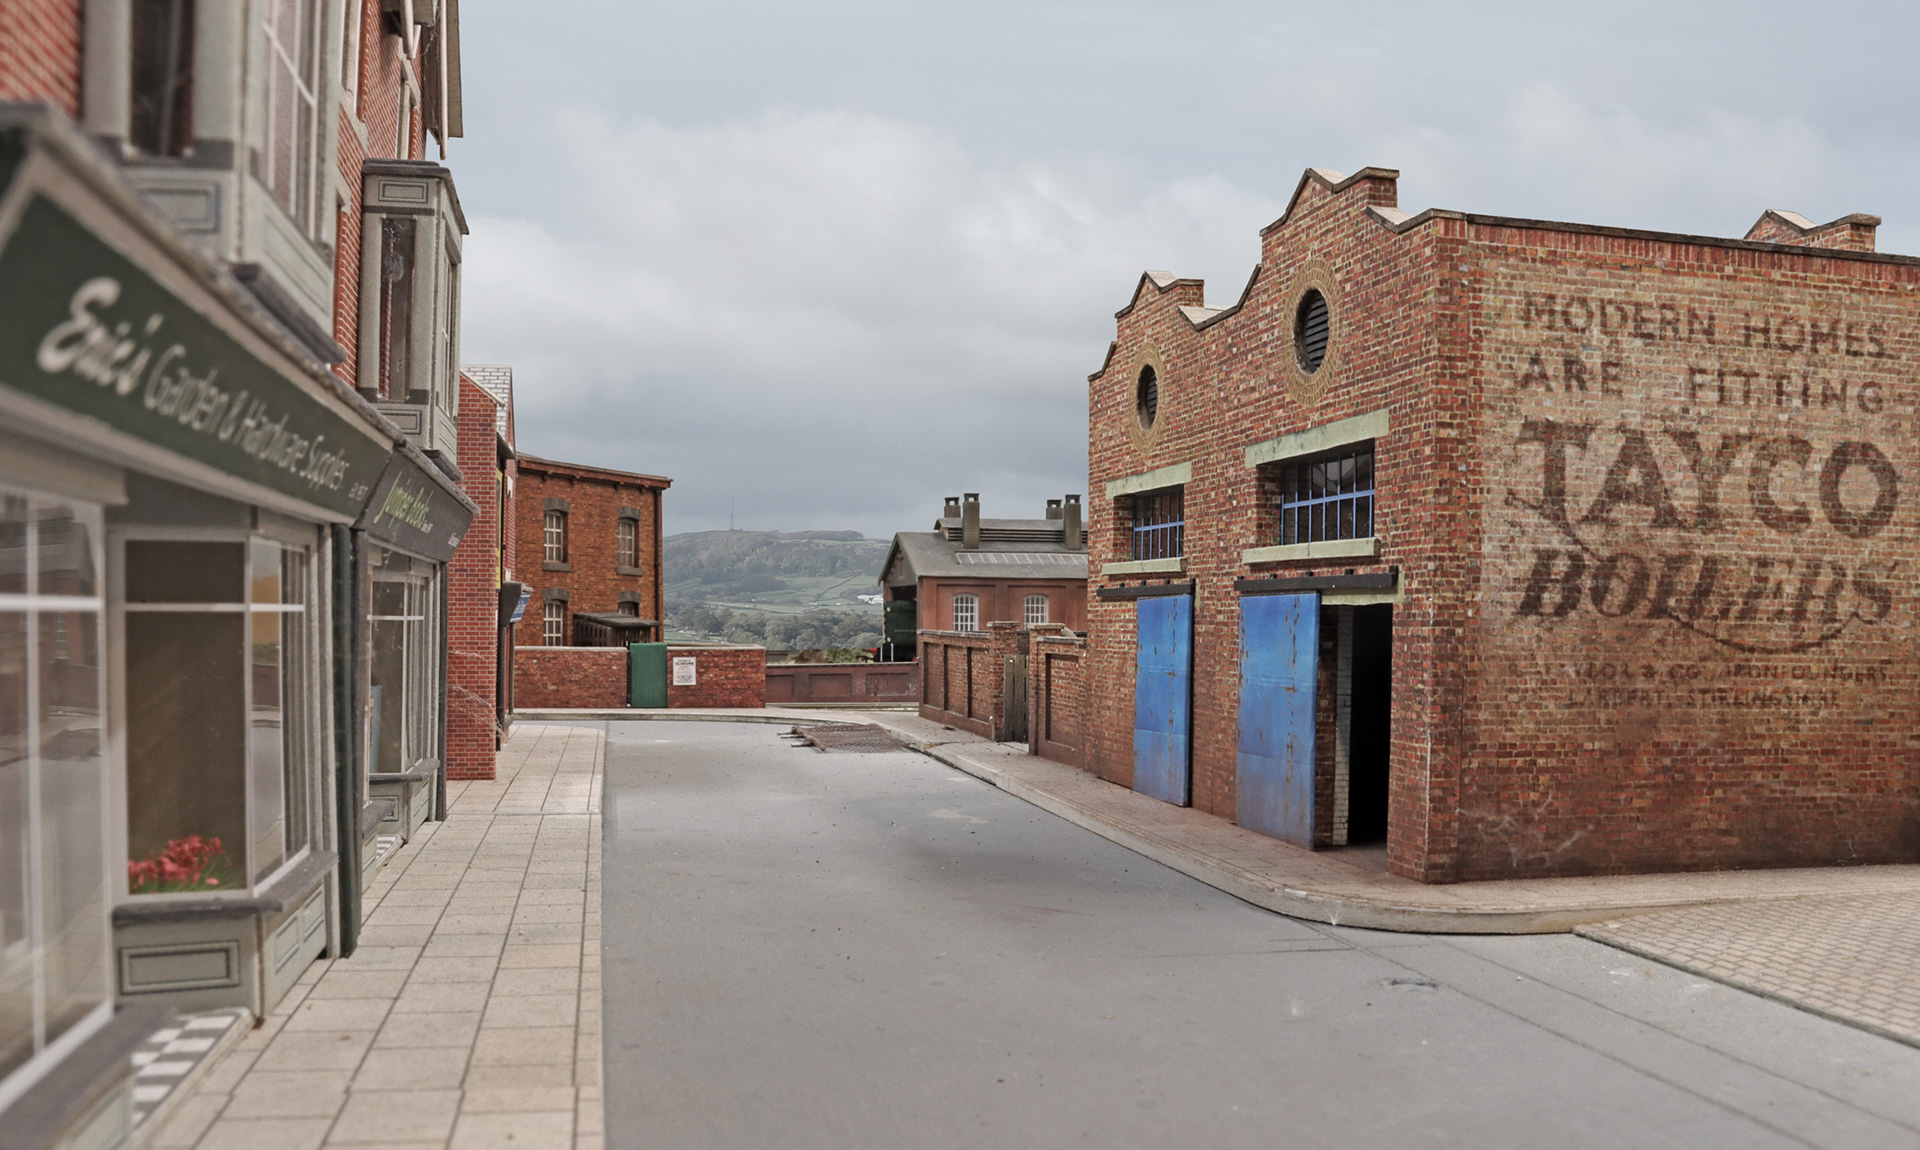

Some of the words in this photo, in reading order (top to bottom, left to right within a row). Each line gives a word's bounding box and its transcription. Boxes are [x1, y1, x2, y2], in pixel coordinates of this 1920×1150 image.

[37, 275, 165, 396] Eric's
[1522, 290, 1716, 346] MODERN
[1743, 312, 1890, 360] HOMES
[144, 344, 230, 434] Garden
[218, 390, 249, 441] &
[1519, 352, 1624, 398] ARE
[1687, 366, 1885, 414] FITTING
[233, 399, 310, 473] Hardware
[299, 434, 350, 492] Supplies
[1514, 419, 1899, 539] TAYCO
[1518, 548, 1898, 625] BOILERS
